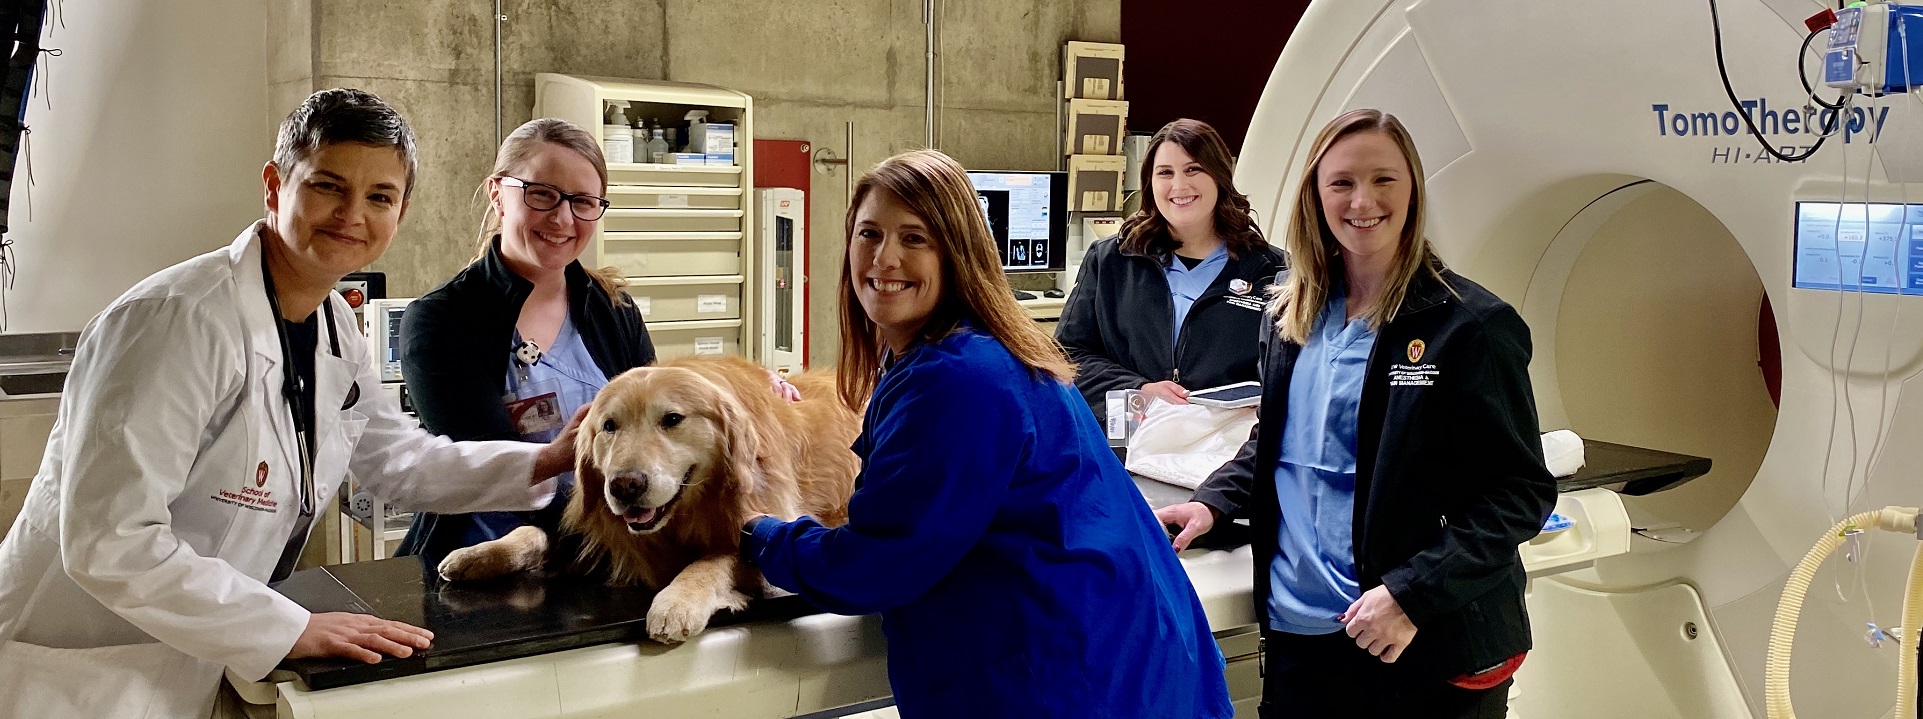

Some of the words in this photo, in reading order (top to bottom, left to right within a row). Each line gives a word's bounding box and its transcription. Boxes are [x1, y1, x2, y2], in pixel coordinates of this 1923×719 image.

[1652, 98, 1890, 144] TomoTherapy
[1411, 346, 1420, 358] W
[219, 489, 256, 504] Veterinary
[257, 498, 277, 507] Medicine
[241, 487, 263, 496] School
